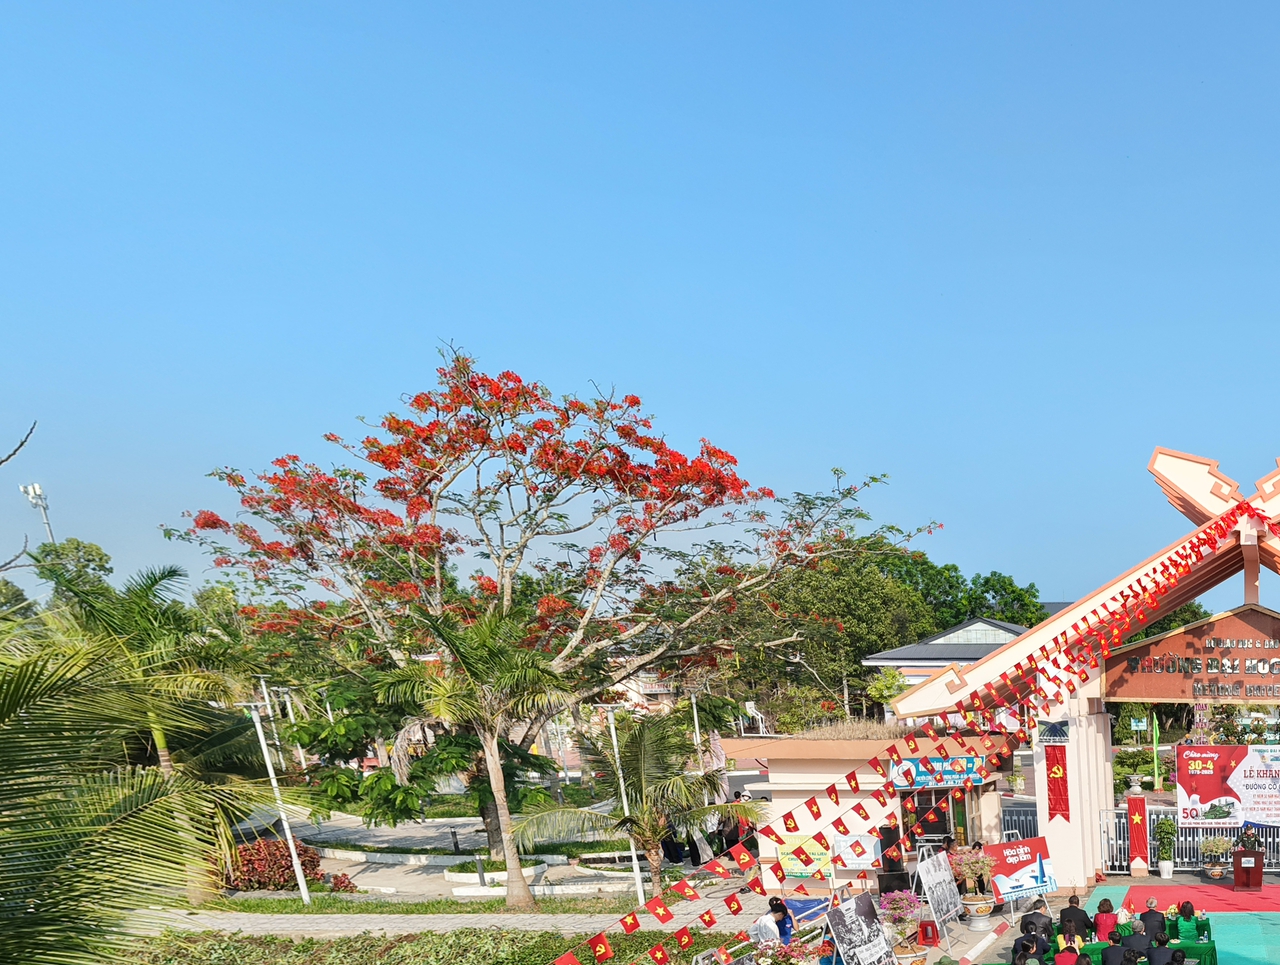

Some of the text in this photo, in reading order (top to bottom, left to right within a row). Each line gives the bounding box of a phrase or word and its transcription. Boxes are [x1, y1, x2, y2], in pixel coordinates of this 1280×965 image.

[1127, 651, 1202, 673] TRƯỜNG
[1207, 658, 1239, 678] ĐẠI
[1245, 658, 1280, 678] HỌC
[1192, 682, 1240, 696] MEKONG
[1188, 760, 1214, 770] 30-4
